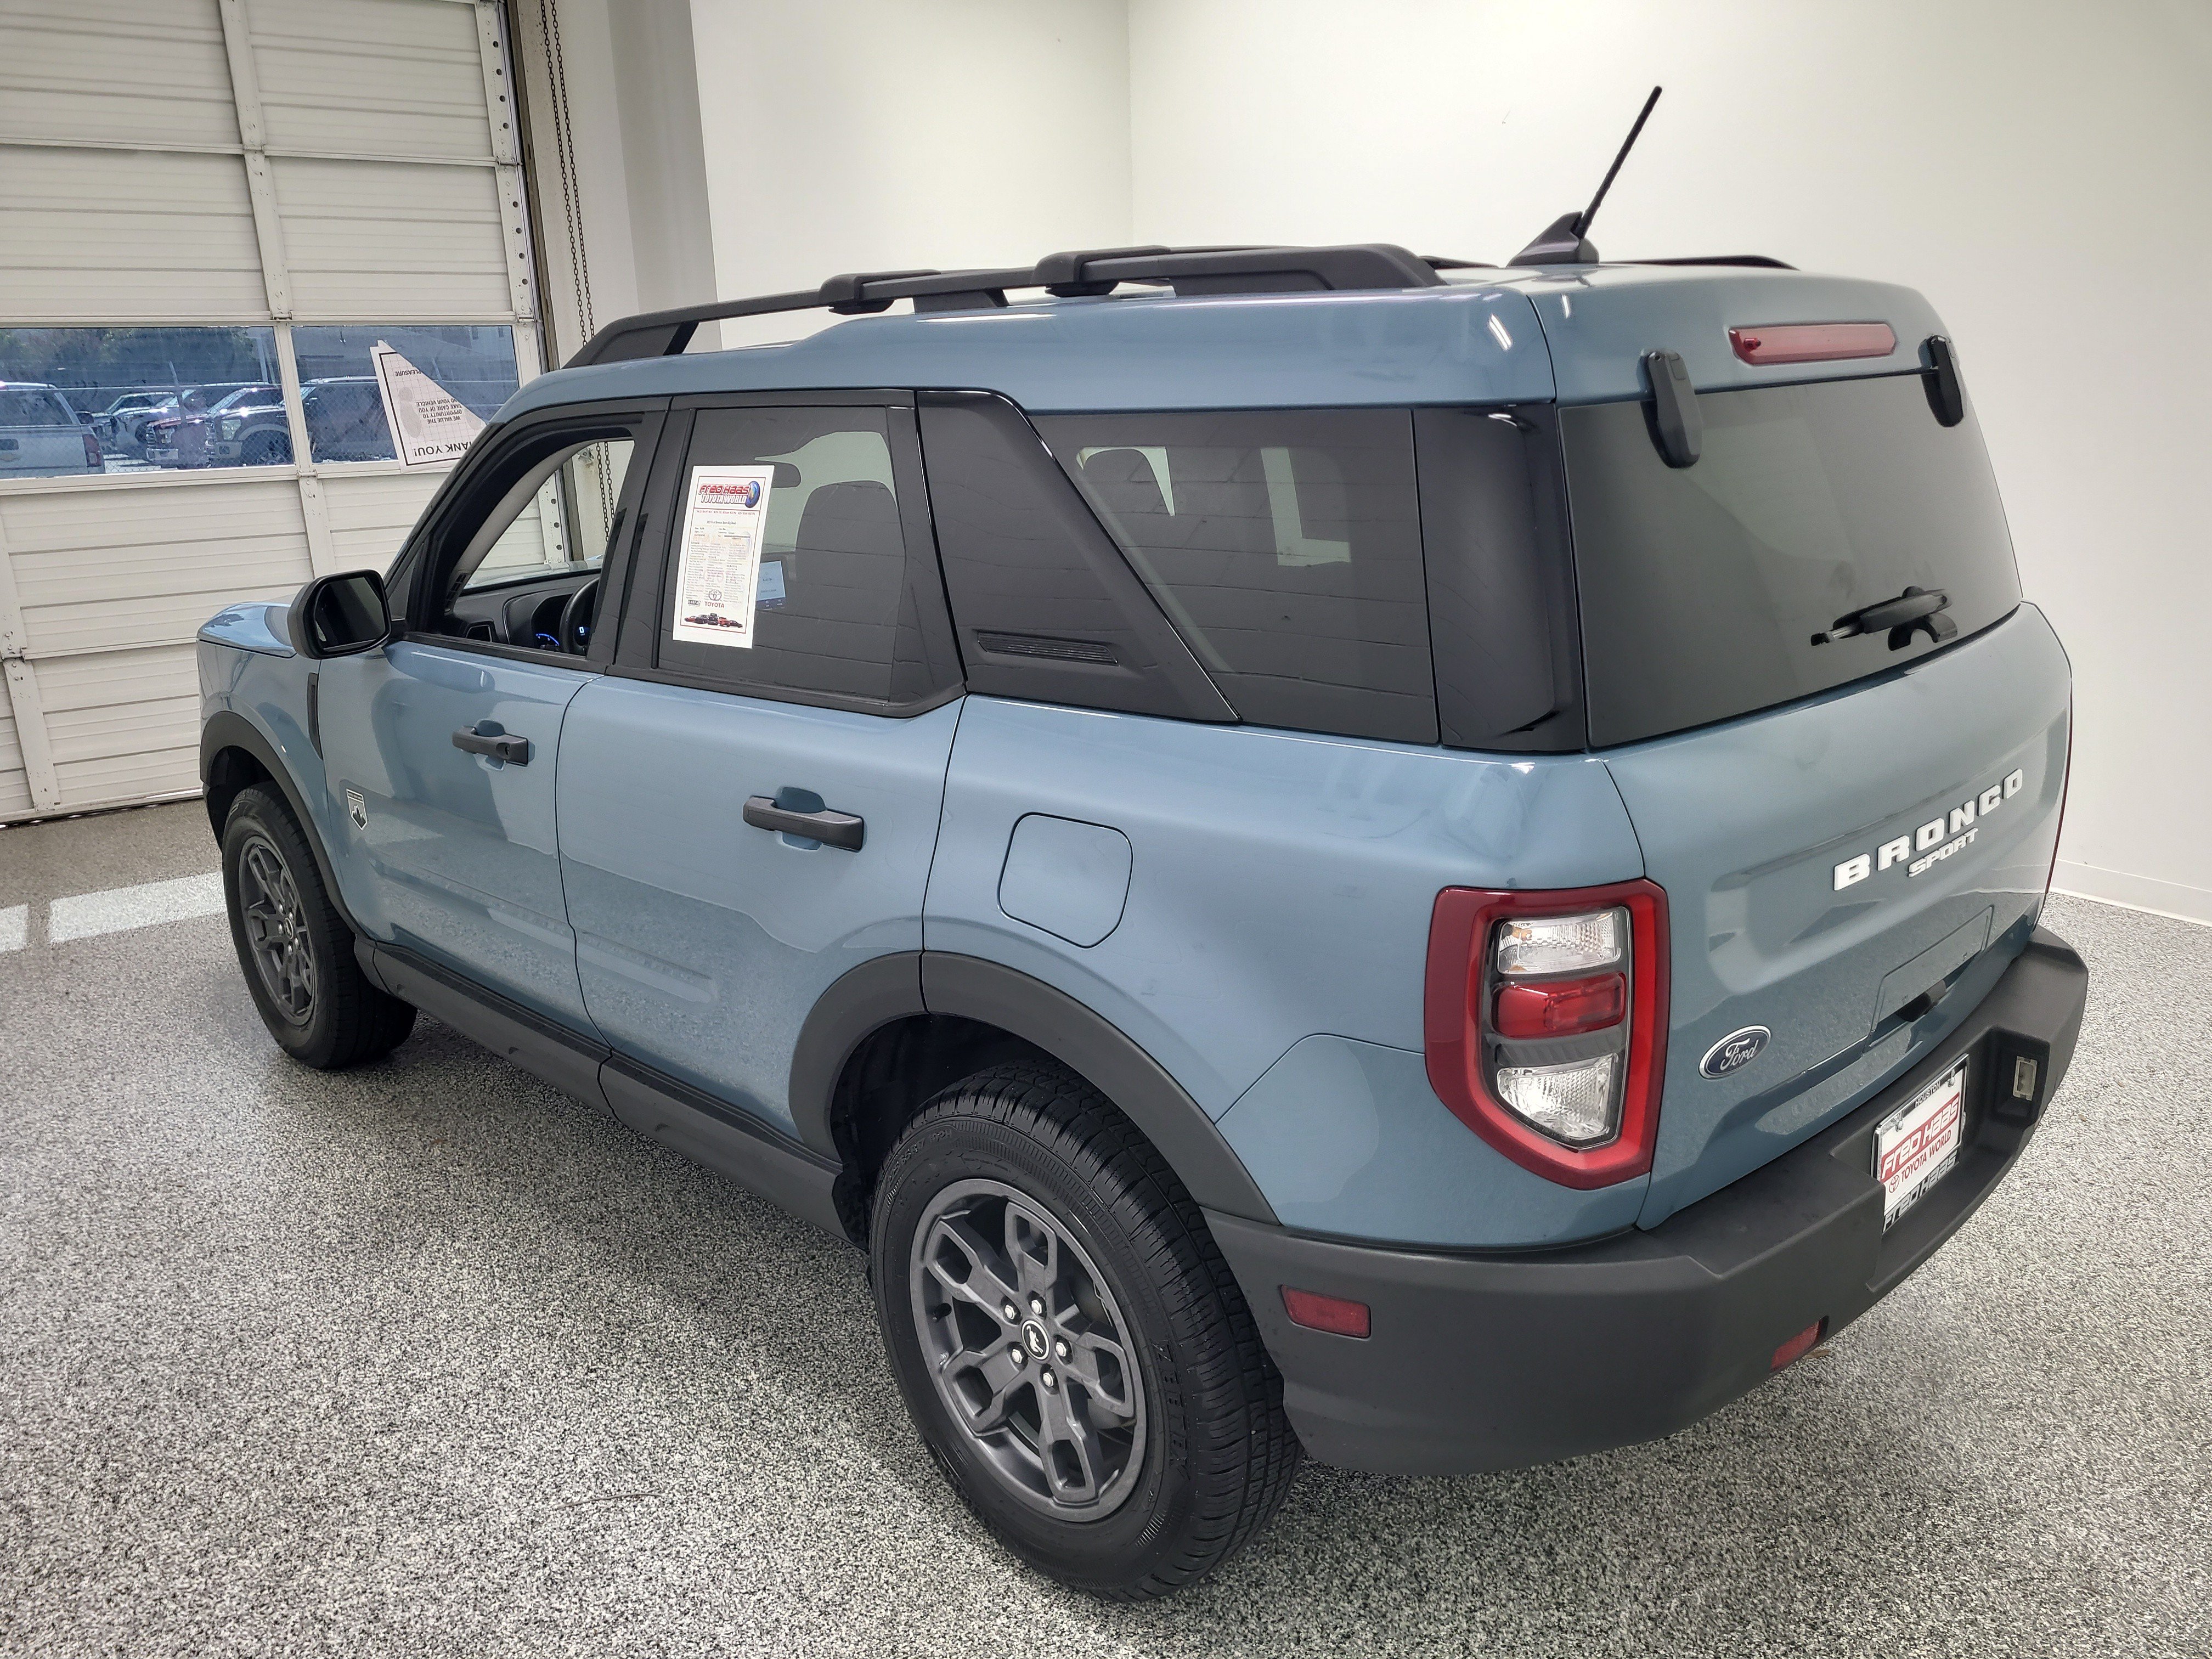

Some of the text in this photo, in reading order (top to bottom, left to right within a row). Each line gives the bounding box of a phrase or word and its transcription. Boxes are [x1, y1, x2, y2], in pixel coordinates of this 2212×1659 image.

[414, 441, 472, 456] ANK YOU!
[701, 494, 747, 504] TOYOTA WORLD
[1833, 768, 2023, 891] BRONCO
[1908, 827, 1978, 877] SPORT
[1720, 1037, 1759, 1070] Ford
[1915, 1080, 1941, 1108] HOUSTON
[1901, 1129, 1951, 1182] TOYOTA WORLD
